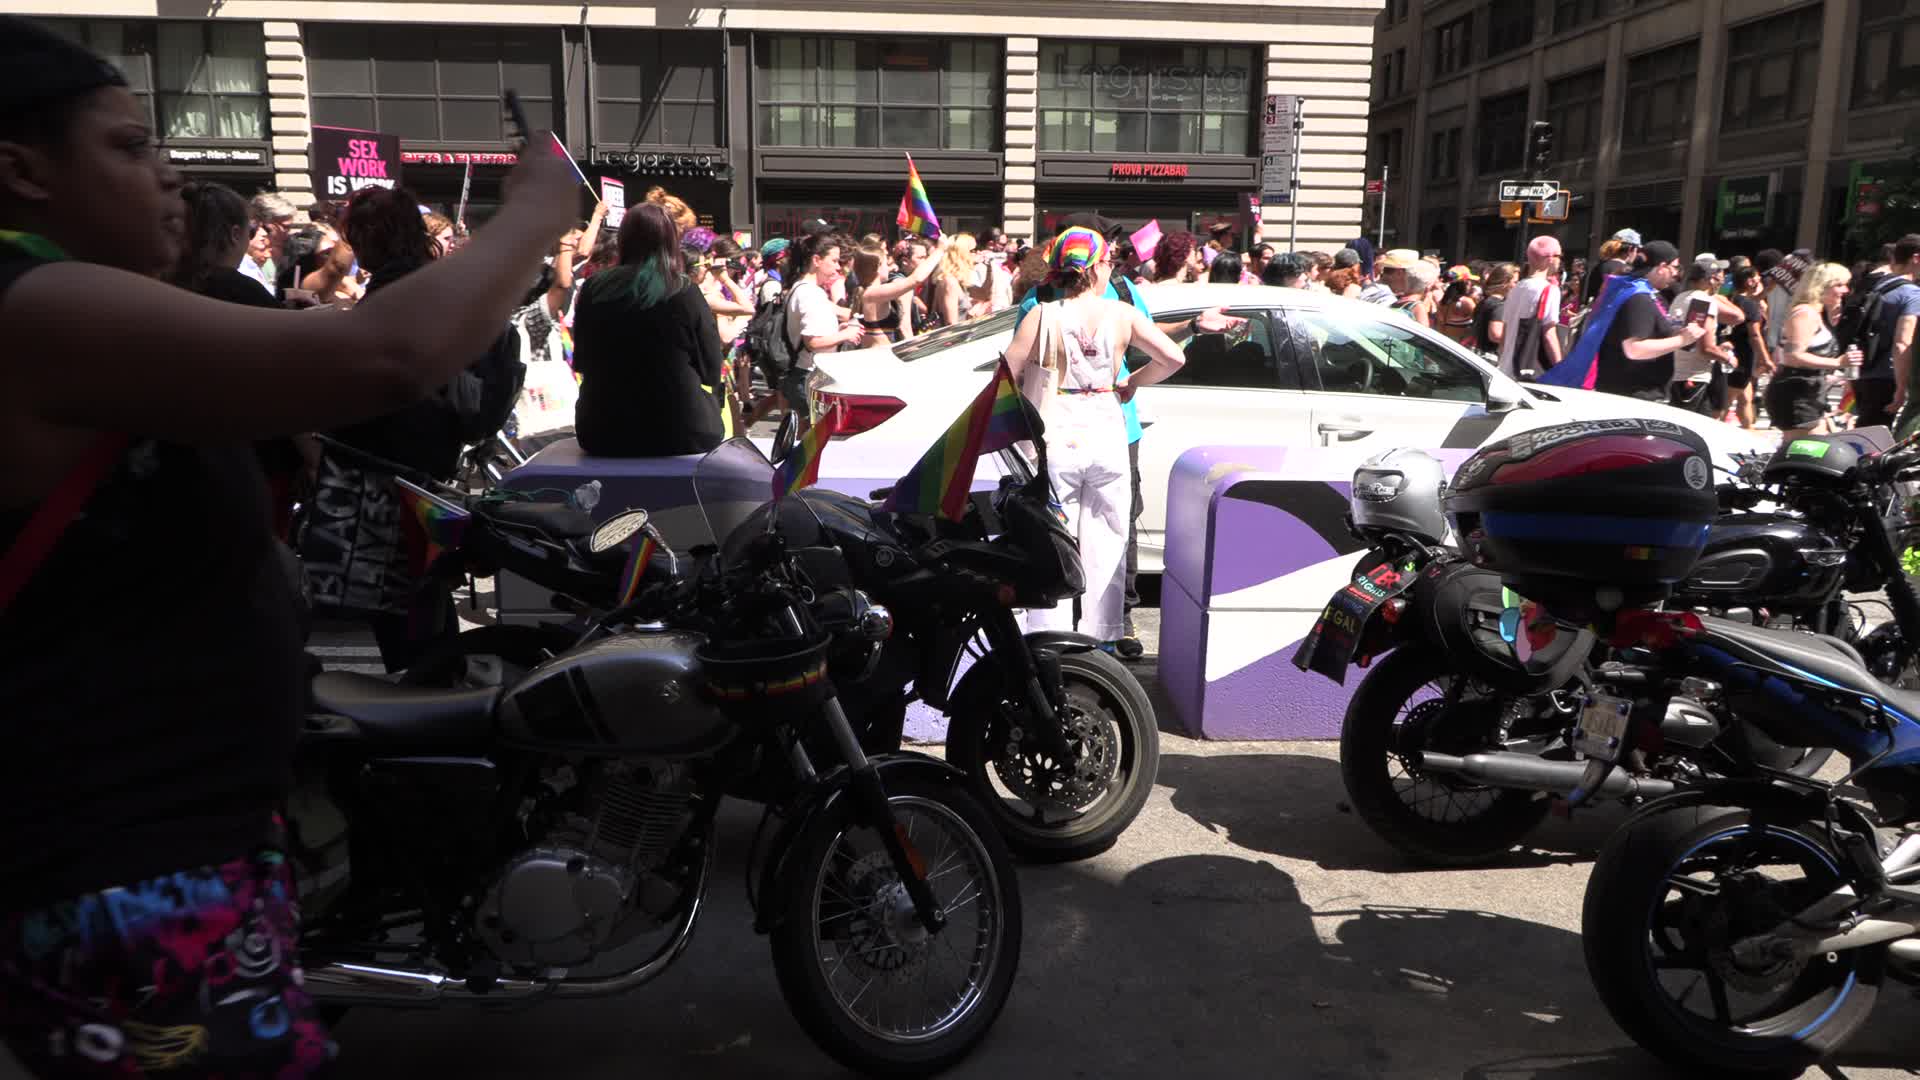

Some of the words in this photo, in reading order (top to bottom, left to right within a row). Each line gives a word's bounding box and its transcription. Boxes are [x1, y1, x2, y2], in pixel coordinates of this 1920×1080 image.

[348, 139, 378, 159] SEX
[401, 152, 441, 163] GIFTS
[338, 157, 387, 178] WORK
[1112, 162, 1141, 175] PROVA
[1144, 163, 1188, 176] PIZZABAR
[327, 176, 347, 195] IS
[1532, 187, 1551, 196] WAY
[302, 455, 362, 609] BLACK
